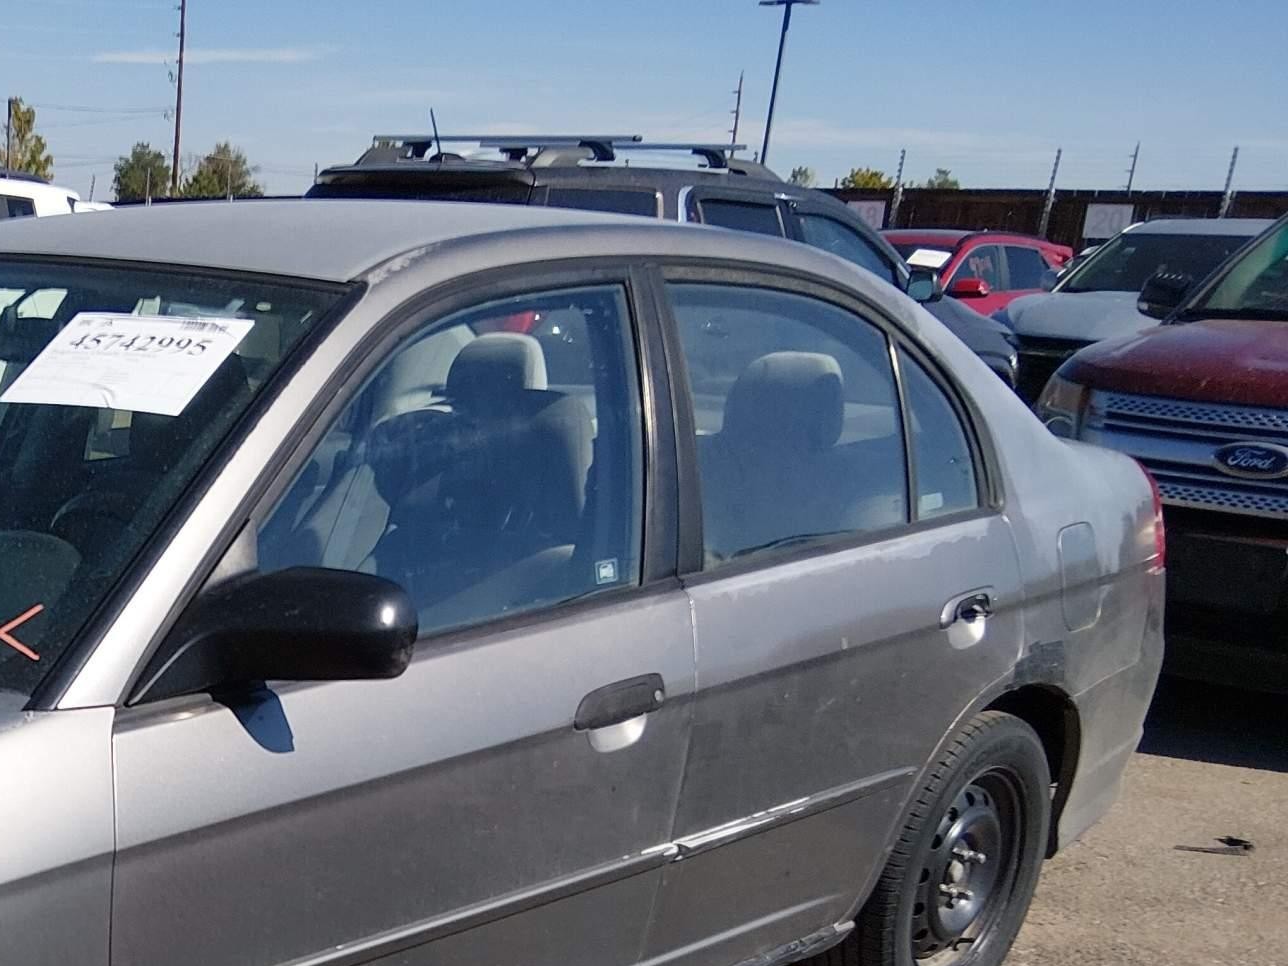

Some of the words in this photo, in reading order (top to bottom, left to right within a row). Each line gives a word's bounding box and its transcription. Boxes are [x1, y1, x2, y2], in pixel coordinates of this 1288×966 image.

[1091, 208, 1124, 233] 20
[70, 334, 213, 356] 45742995
[1227, 448, 1276, 470] Ford
